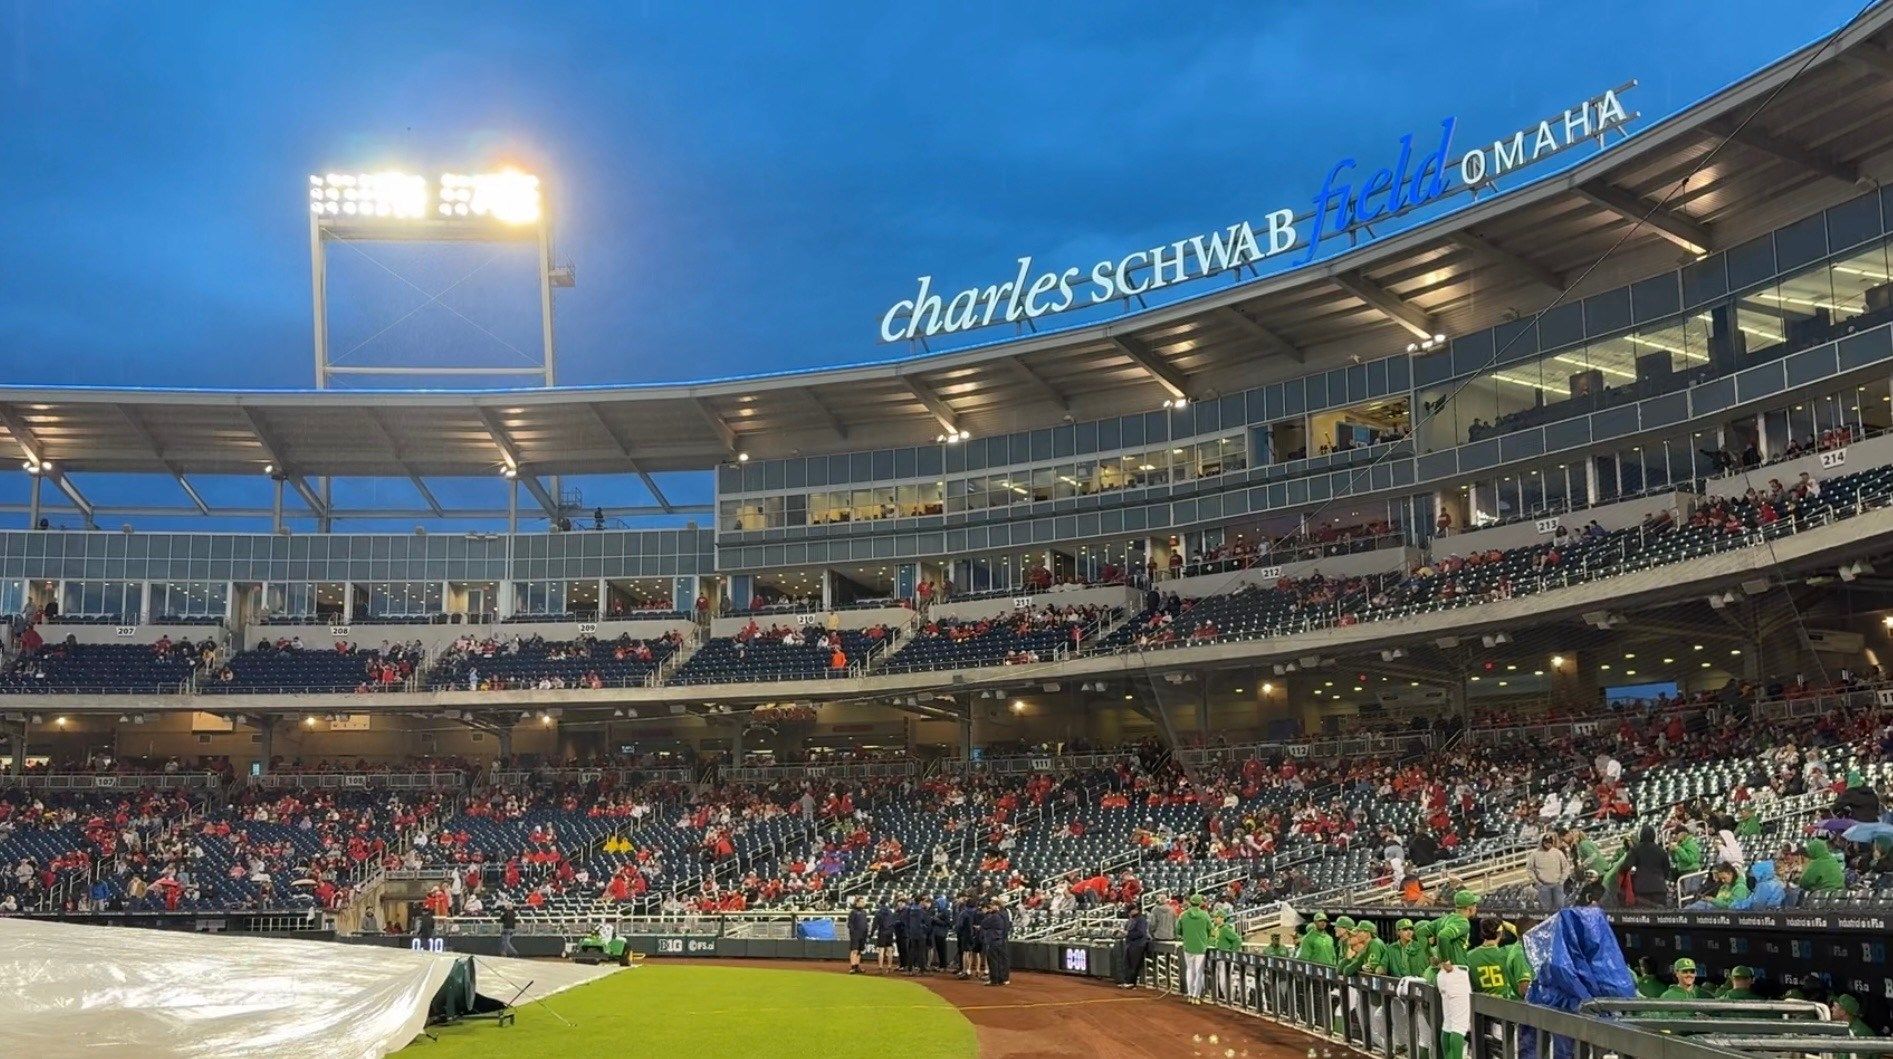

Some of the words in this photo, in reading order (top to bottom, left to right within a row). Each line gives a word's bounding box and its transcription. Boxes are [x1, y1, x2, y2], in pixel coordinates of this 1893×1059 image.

[881, 256, 1080, 342] charles
[1091, 208, 1297, 302] SCHWAB
[1292, 116, 1457, 266] field
[1462, 90, 1627, 184] OMAHA
[1823, 451, 1844, 465] 214
[1539, 519, 1556, 531] 213
[1264, 569, 1279, 577] 212
[800, 615, 814, 623] 210
[580, 624, 595, 632] 209
[1476, 965, 1505, 988] 26
